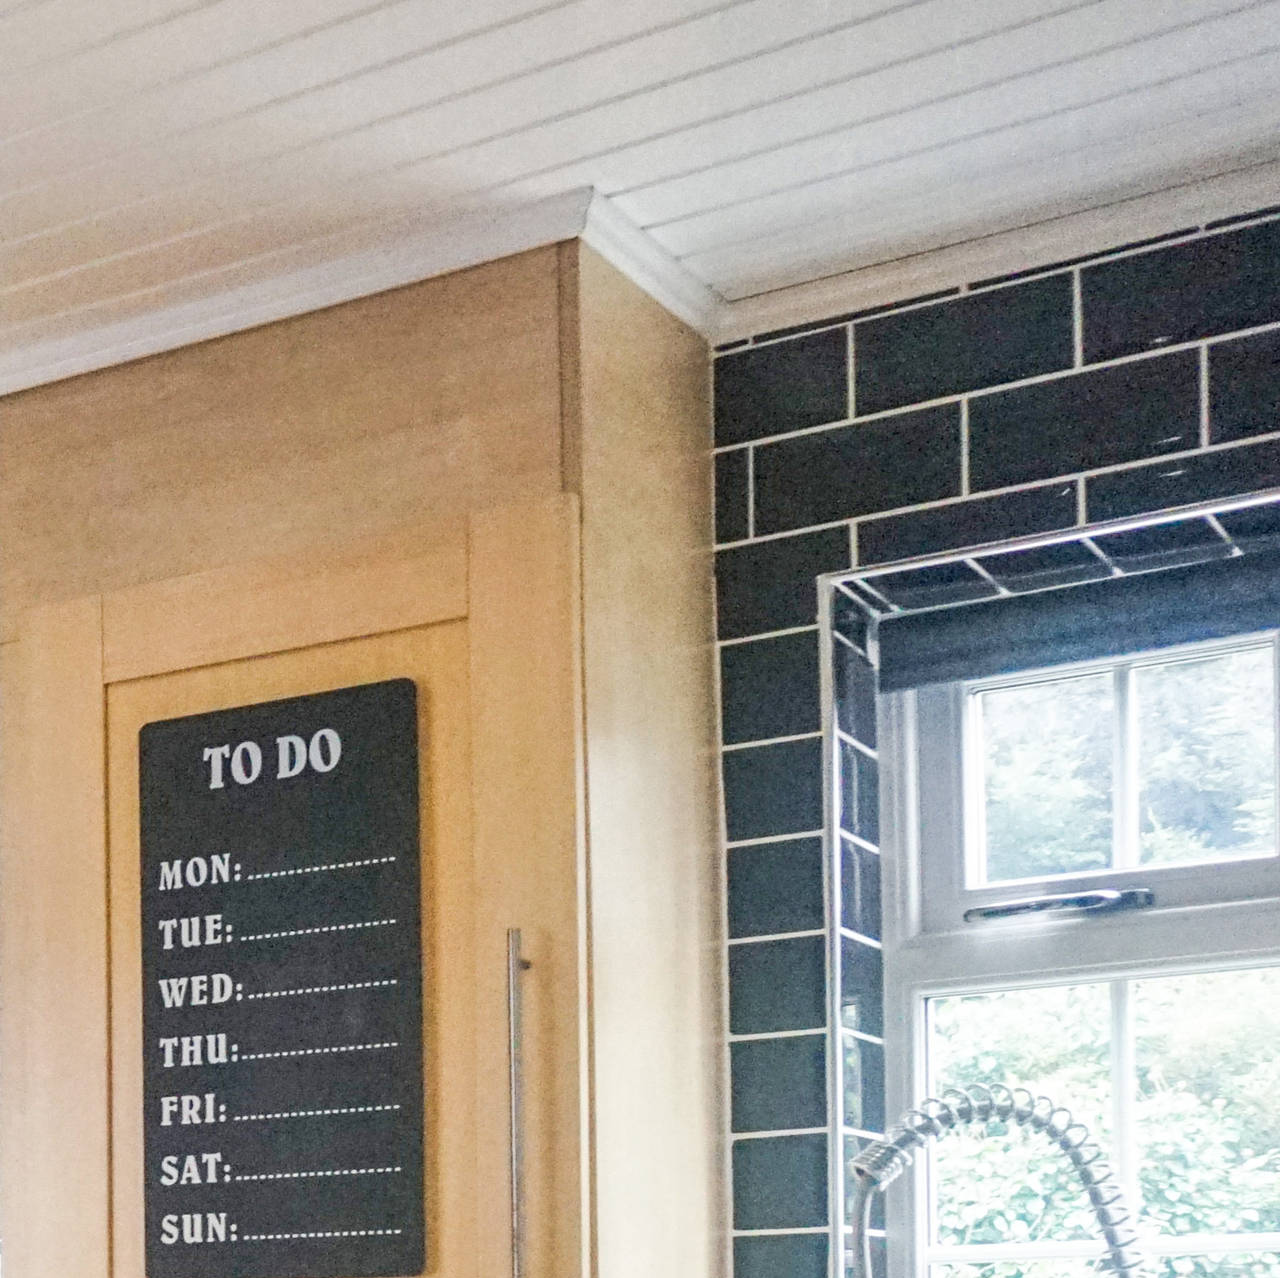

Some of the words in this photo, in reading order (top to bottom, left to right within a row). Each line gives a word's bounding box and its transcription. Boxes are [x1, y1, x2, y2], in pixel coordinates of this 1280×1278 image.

[203, 739, 263, 790] TO
[276, 727, 343, 780] DO
[158, 853, 243, 891] MON:
[158, 913, 234, 950] TUE:
[158, 972, 244, 1008] WED:
[159, 1032, 239, 1068] THU:
[160, 1093, 227, 1127] FRI:
[160, 1152, 232, 1187] SAT:
[160, 1212, 239, 1246] SUN:
